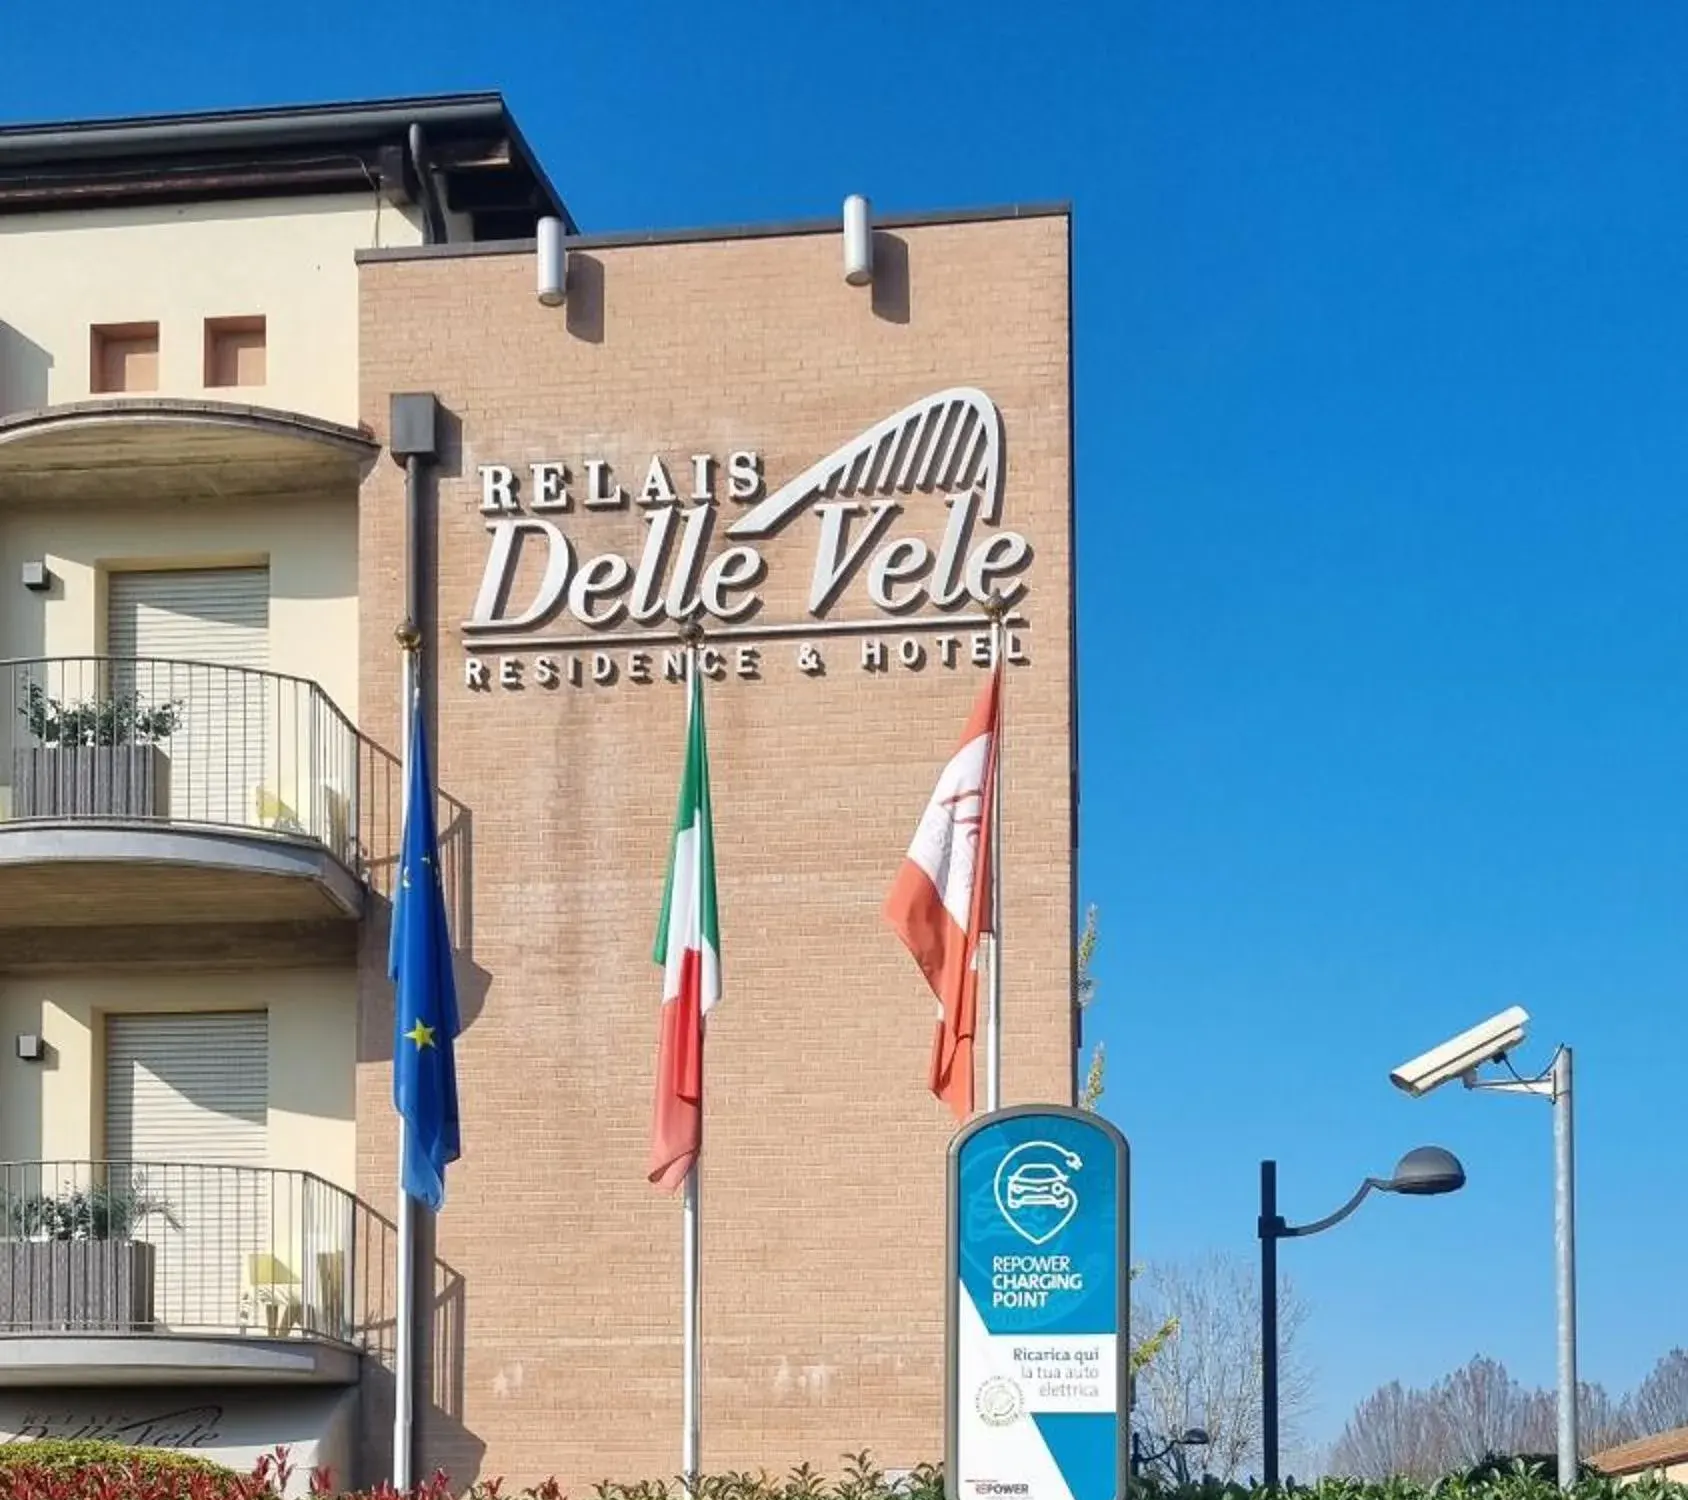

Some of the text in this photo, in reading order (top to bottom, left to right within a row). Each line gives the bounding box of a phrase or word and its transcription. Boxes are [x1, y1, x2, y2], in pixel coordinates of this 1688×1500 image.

[478, 450, 763, 511] RELAIS
[463, 489, 1029, 629] Delle Vele
[464, 629, 1024, 686] RESIDENCE & HOTEL
[993, 1256, 1070, 1273] REPOWER
[992, 1274, 1083, 1291] CHARGING
[992, 1292, 1049, 1308] POINT
[1013, 1347, 1100, 1365] Ricarica qui
[1021, 1365, 1099, 1379] la tua auto
[1039, 1382, 1099, 1398] elettrica
